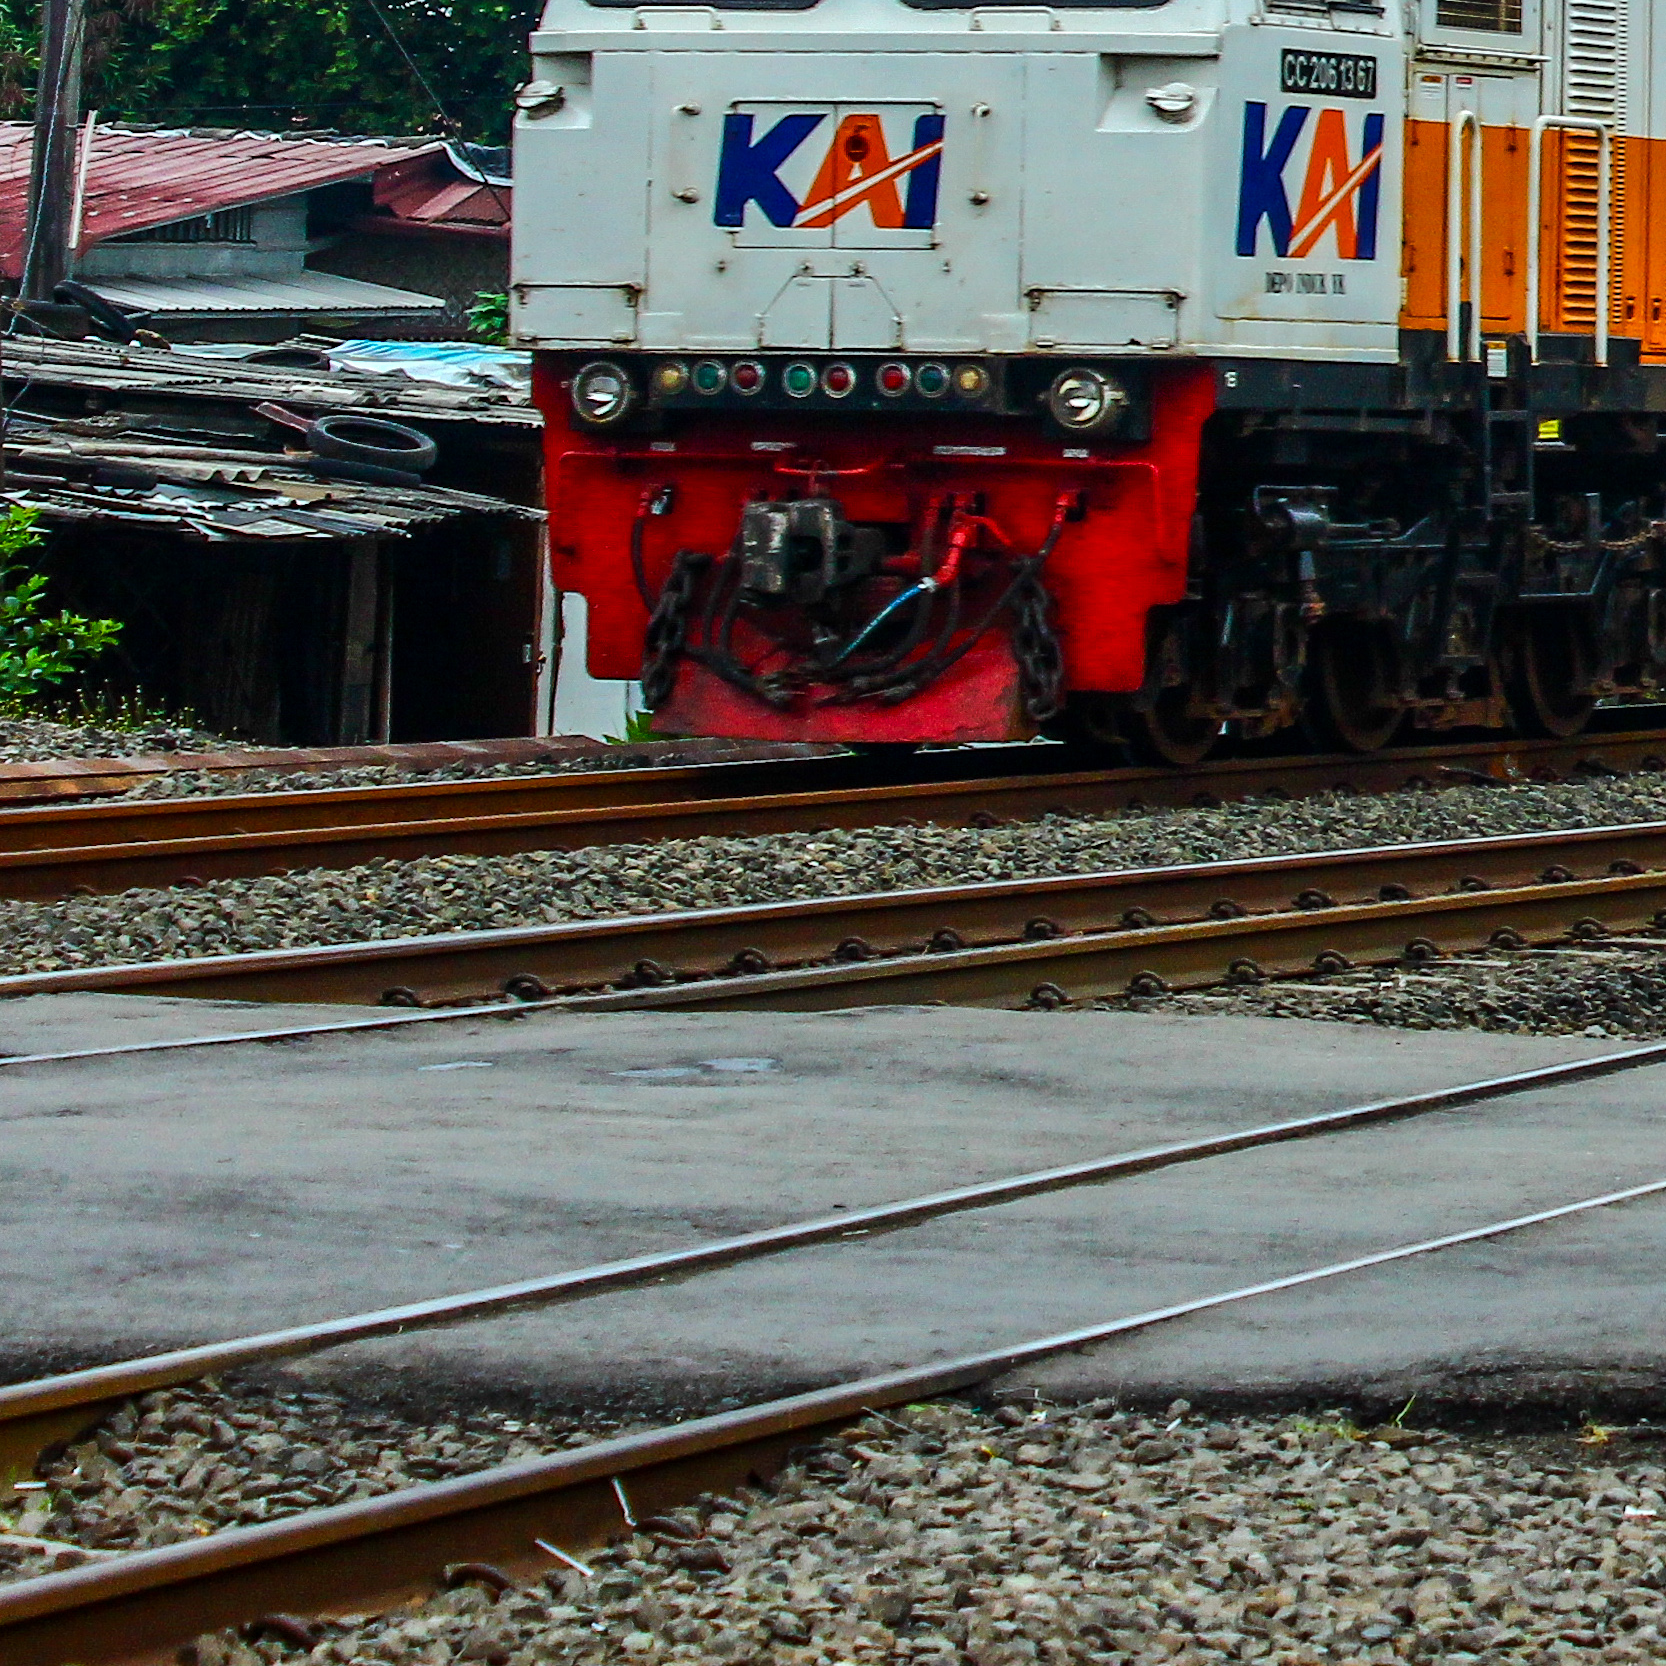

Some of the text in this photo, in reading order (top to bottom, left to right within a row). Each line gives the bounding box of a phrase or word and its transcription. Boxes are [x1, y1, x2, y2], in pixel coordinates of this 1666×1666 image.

[1283, 54, 1307, 87] CC
[714, 113, 946, 229] KAI
[1236, 100, 1385, 260] KAI
